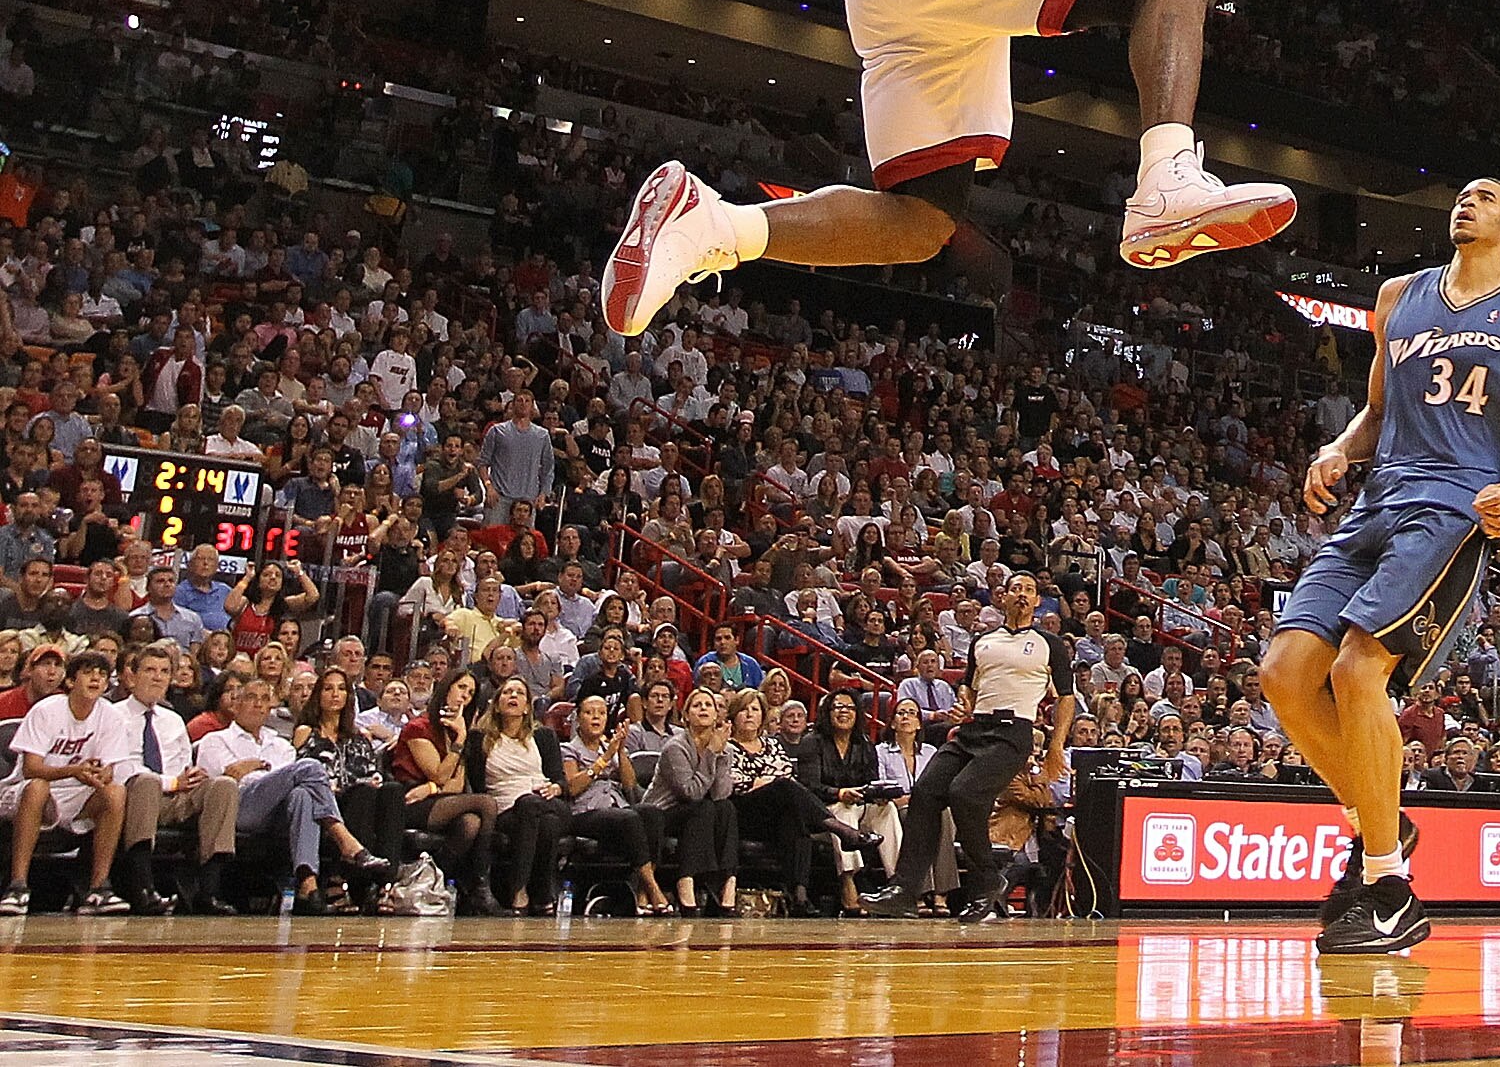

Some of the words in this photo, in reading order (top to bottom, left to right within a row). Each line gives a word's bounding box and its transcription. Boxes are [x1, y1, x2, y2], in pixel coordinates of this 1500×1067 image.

[1424, 356, 1489, 416] 34
[155, 461, 225, 494] 2:14
[162, 516, 183, 546] 2
[215, 522, 254, 551] 37
[1199, 821, 1309, 881] State
[1310, 825, 1354, 881] Fa
